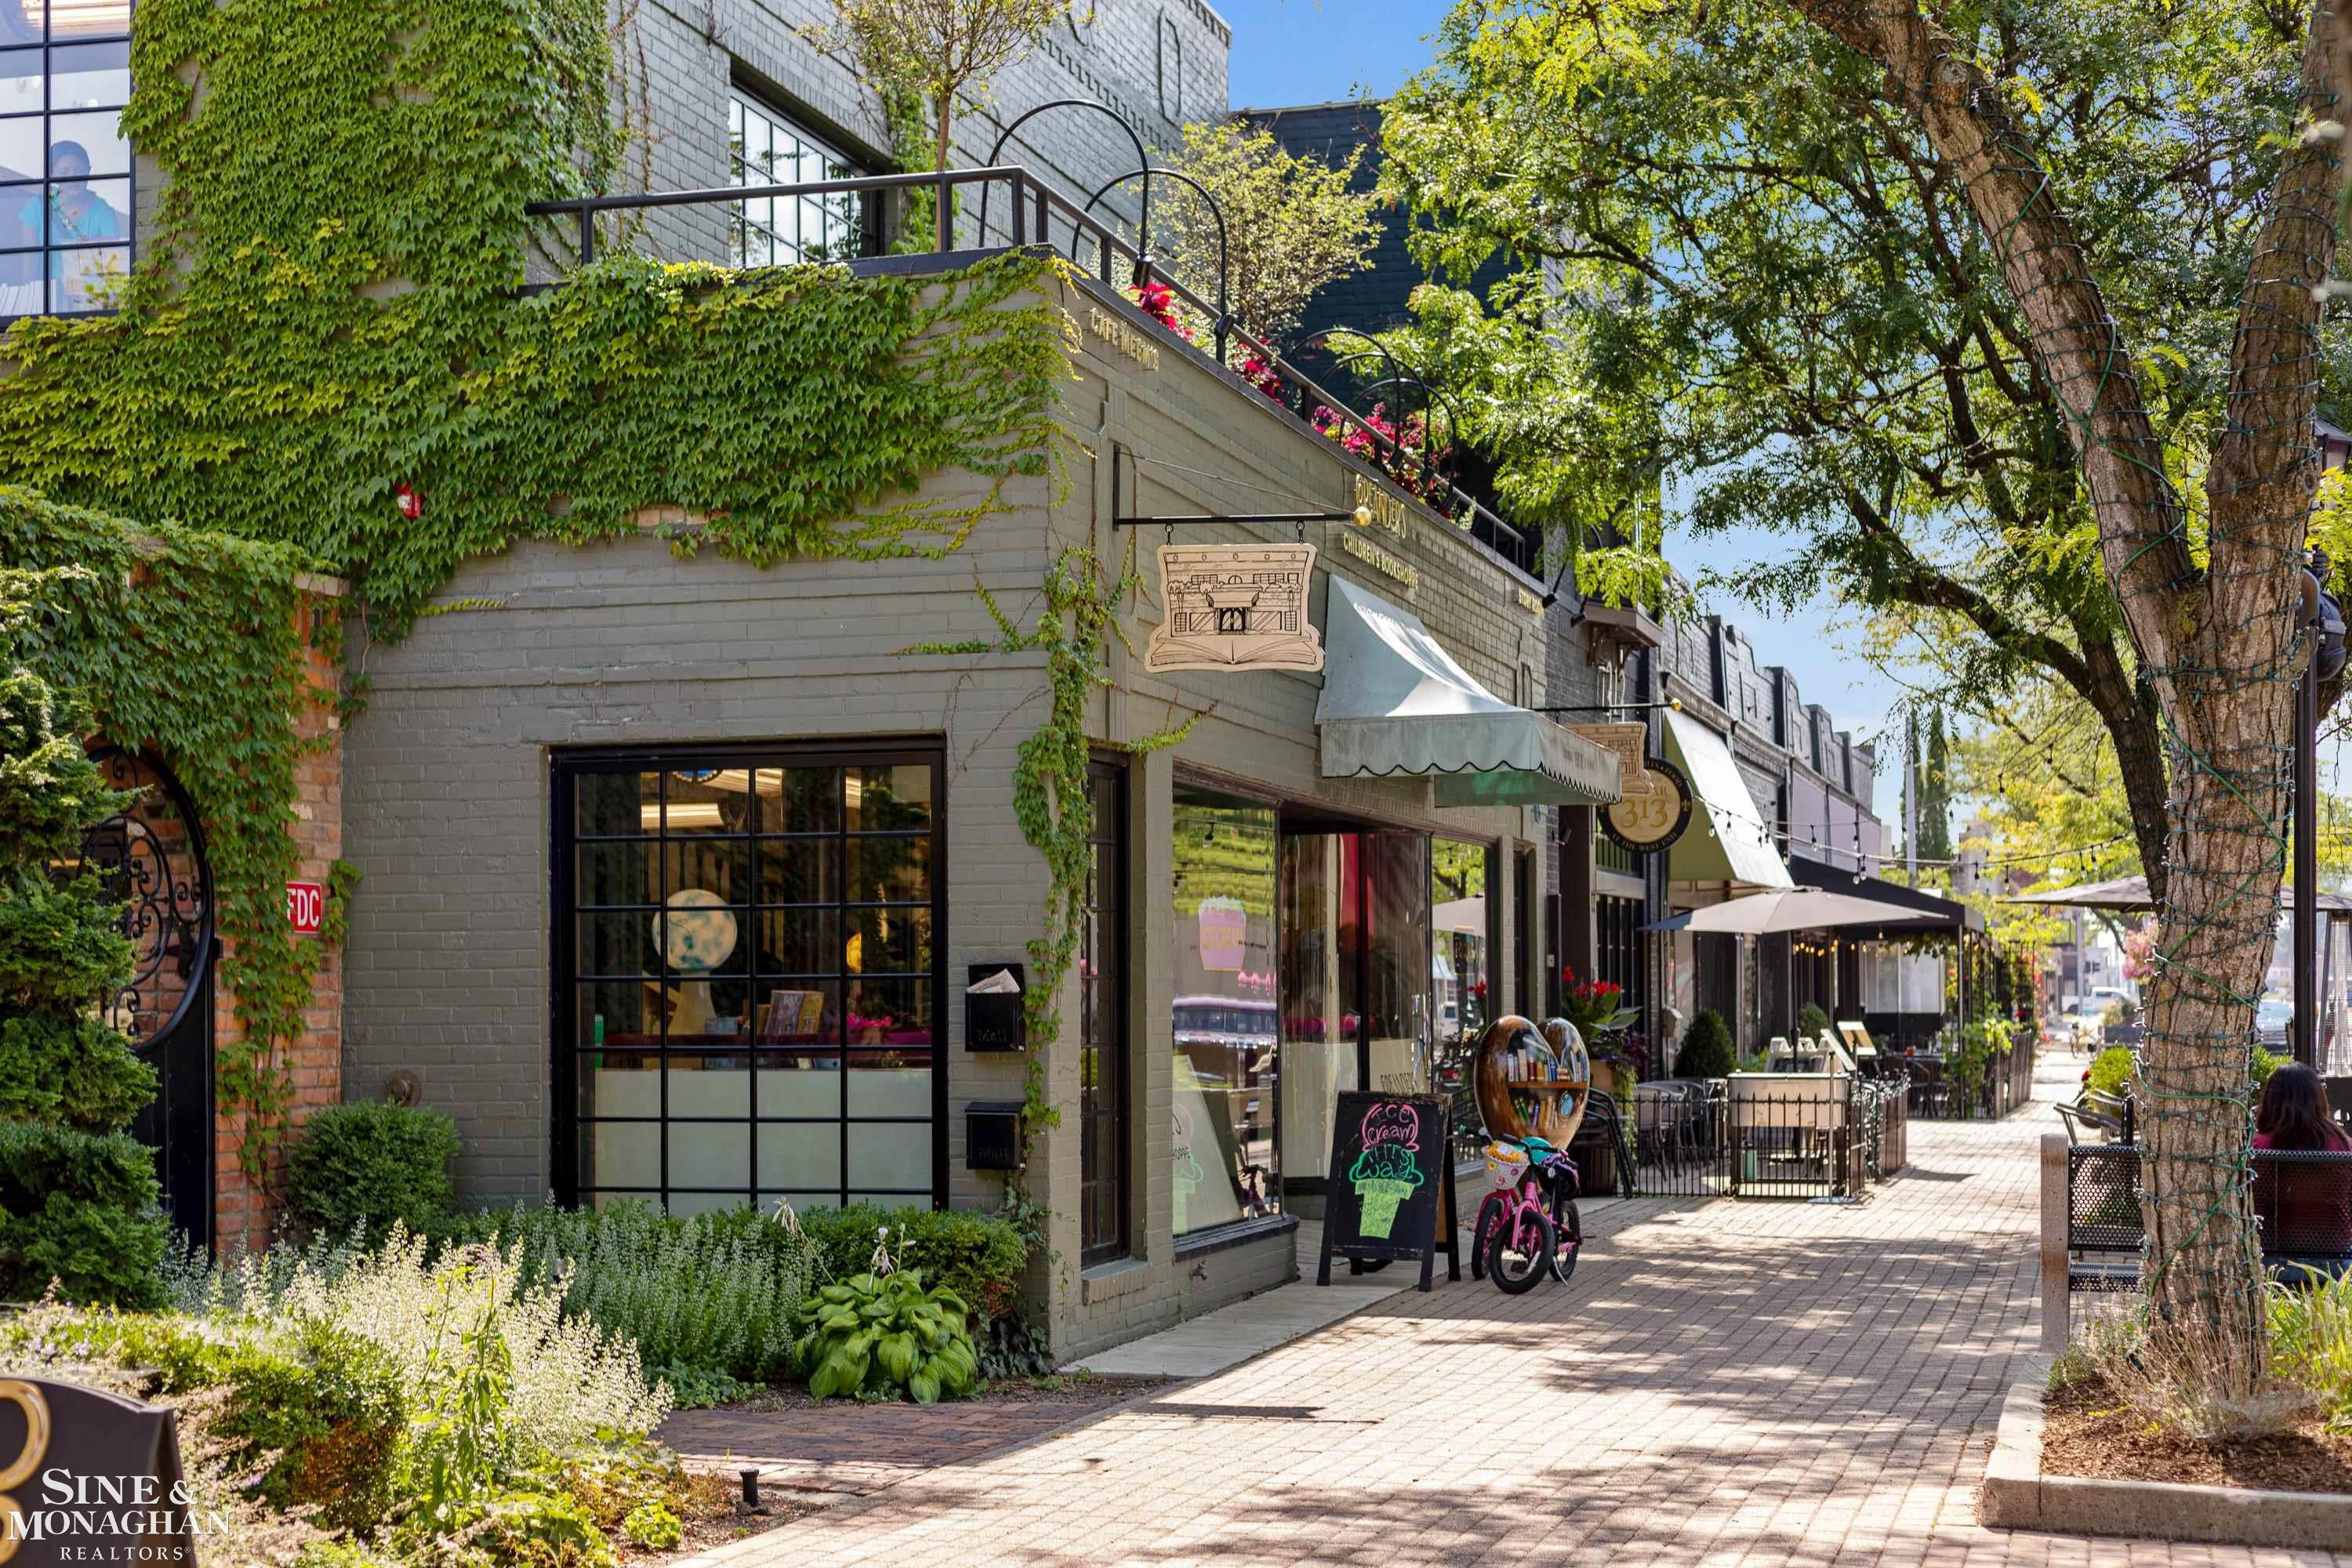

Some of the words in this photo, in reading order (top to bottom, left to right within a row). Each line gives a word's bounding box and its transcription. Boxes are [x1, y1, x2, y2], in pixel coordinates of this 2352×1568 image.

[1343, 532, 1380, 568] CHILDREN'S
[1619, 798, 1668, 829] 313
[286, 888, 320, 927] FDC
